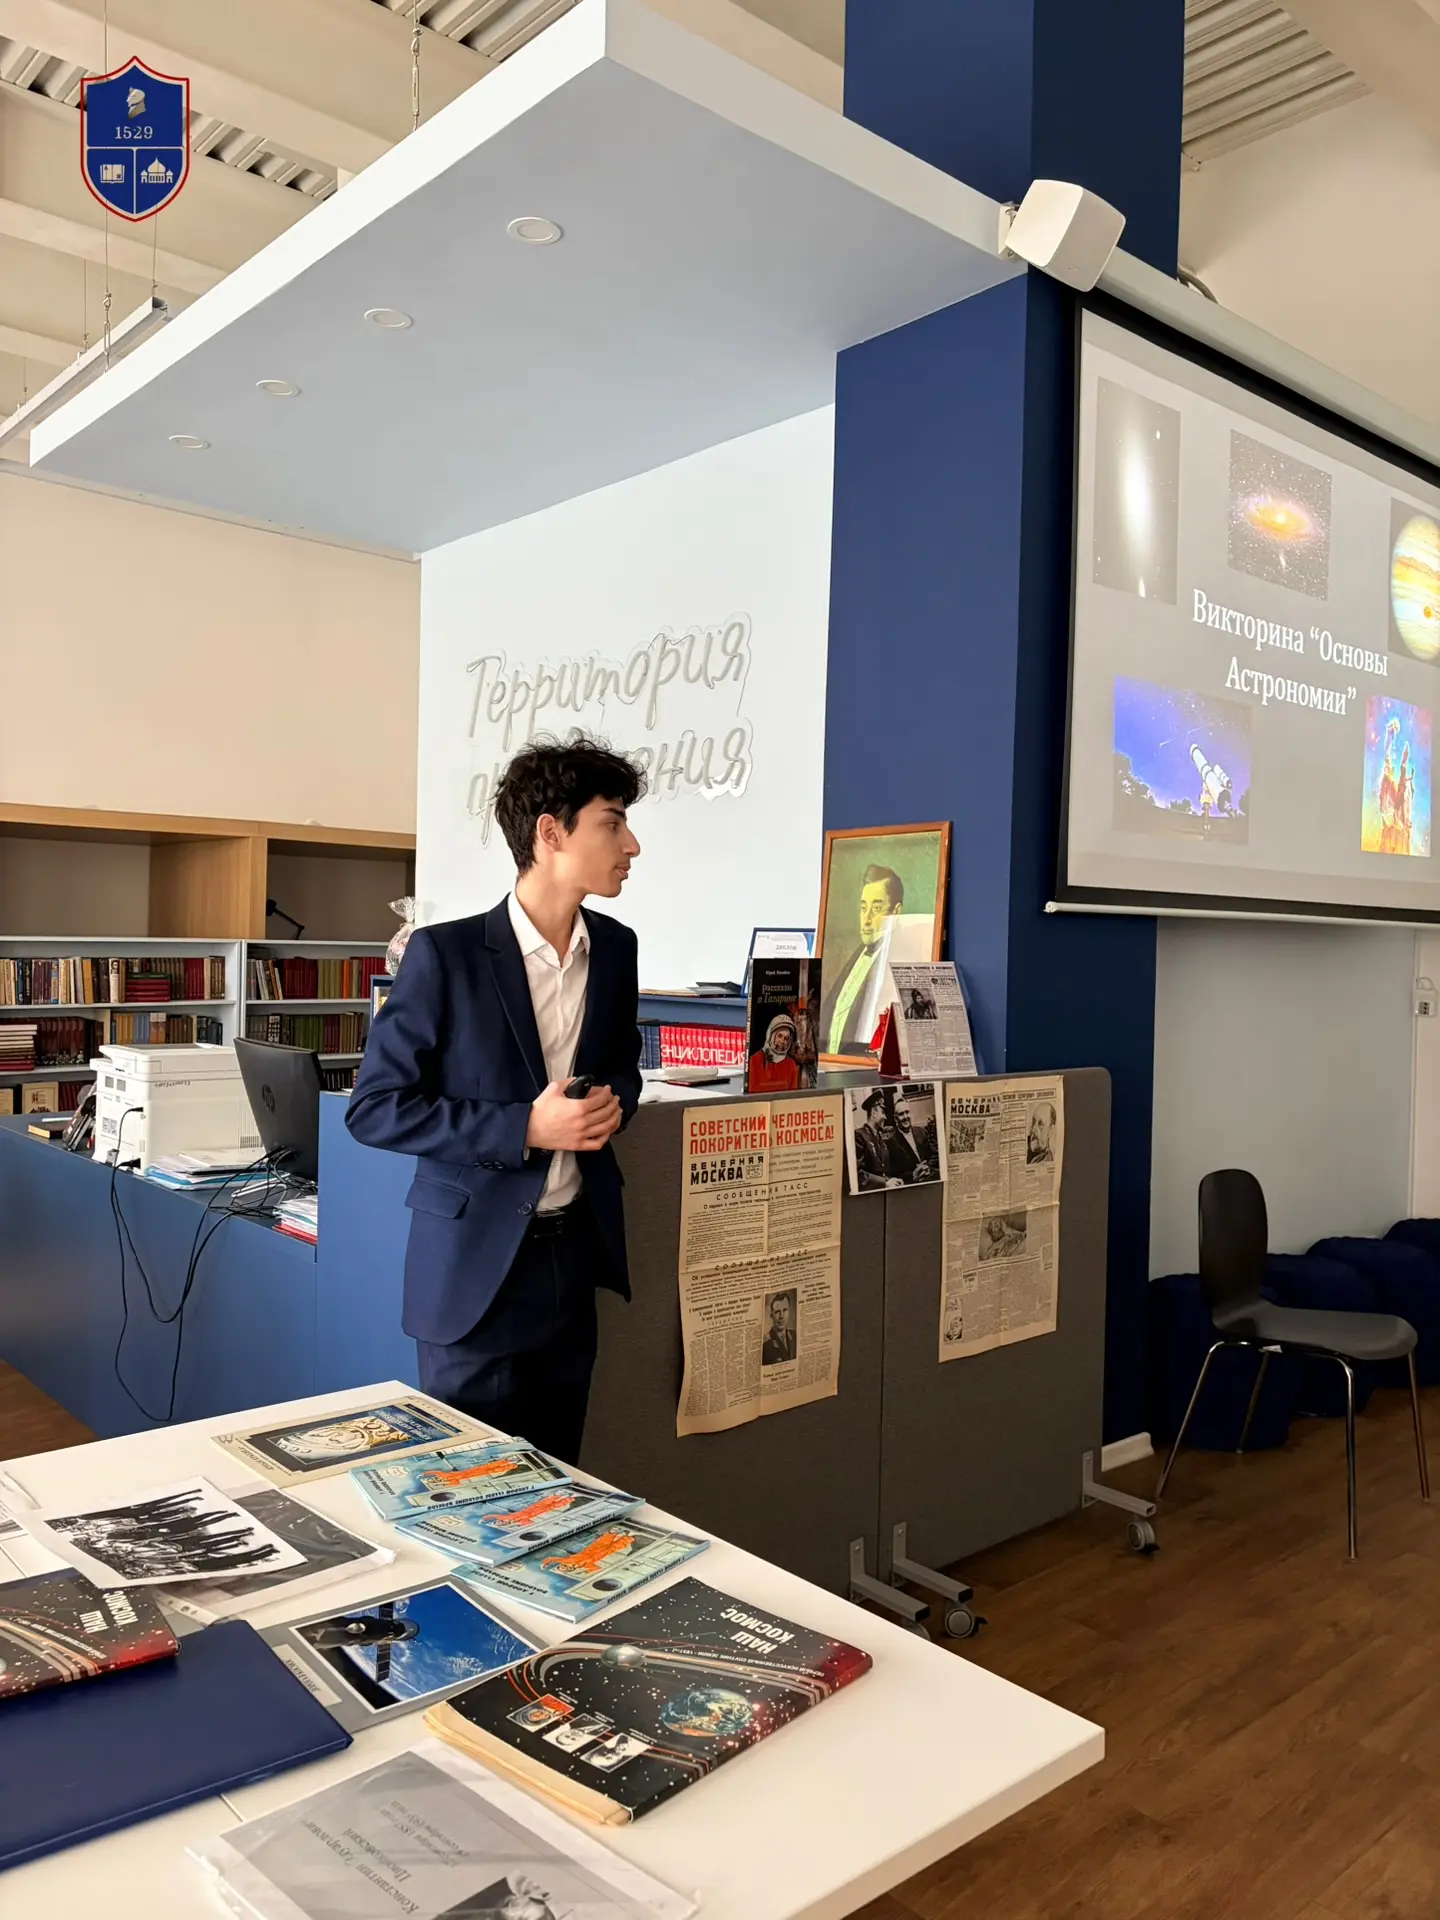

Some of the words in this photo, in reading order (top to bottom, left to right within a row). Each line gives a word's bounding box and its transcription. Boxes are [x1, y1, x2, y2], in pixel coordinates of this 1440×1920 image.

[1192, 588, 1304, 654] Викторина
[1310, 626, 1388, 677] “Основы
[466, 621, 745, 753] Территория
[1225, 656, 1357, 716] Астрономии”
[762, 984, 793, 995] Рассказы
[950, 1104, 990, 1114] МОСКВА
[690, 1114, 767, 1138] СОВЕТСКИЙ
[690, 1132, 773, 1155] ПОКОРИТЕЛЬ
[776, 1125, 835, 1146] КОСМОСА!
[691, 1156, 764, 1171] ВЕЧЕРНЯЯ
[690, 1166, 743, 1186] МОСКВА
[784, 1182, 808, 1191] ТАСС
[102, 1590, 139, 1626] КОСМОС
[80, 1610, 109, 1633] НАШ
[719, 1607, 795, 1642] КОСМОС
[697, 1650, 718, 1658] ЗЕМЛИ
[730, 1631, 778, 1655] НАШ
[355, 1863, 420, 1915] Константин
